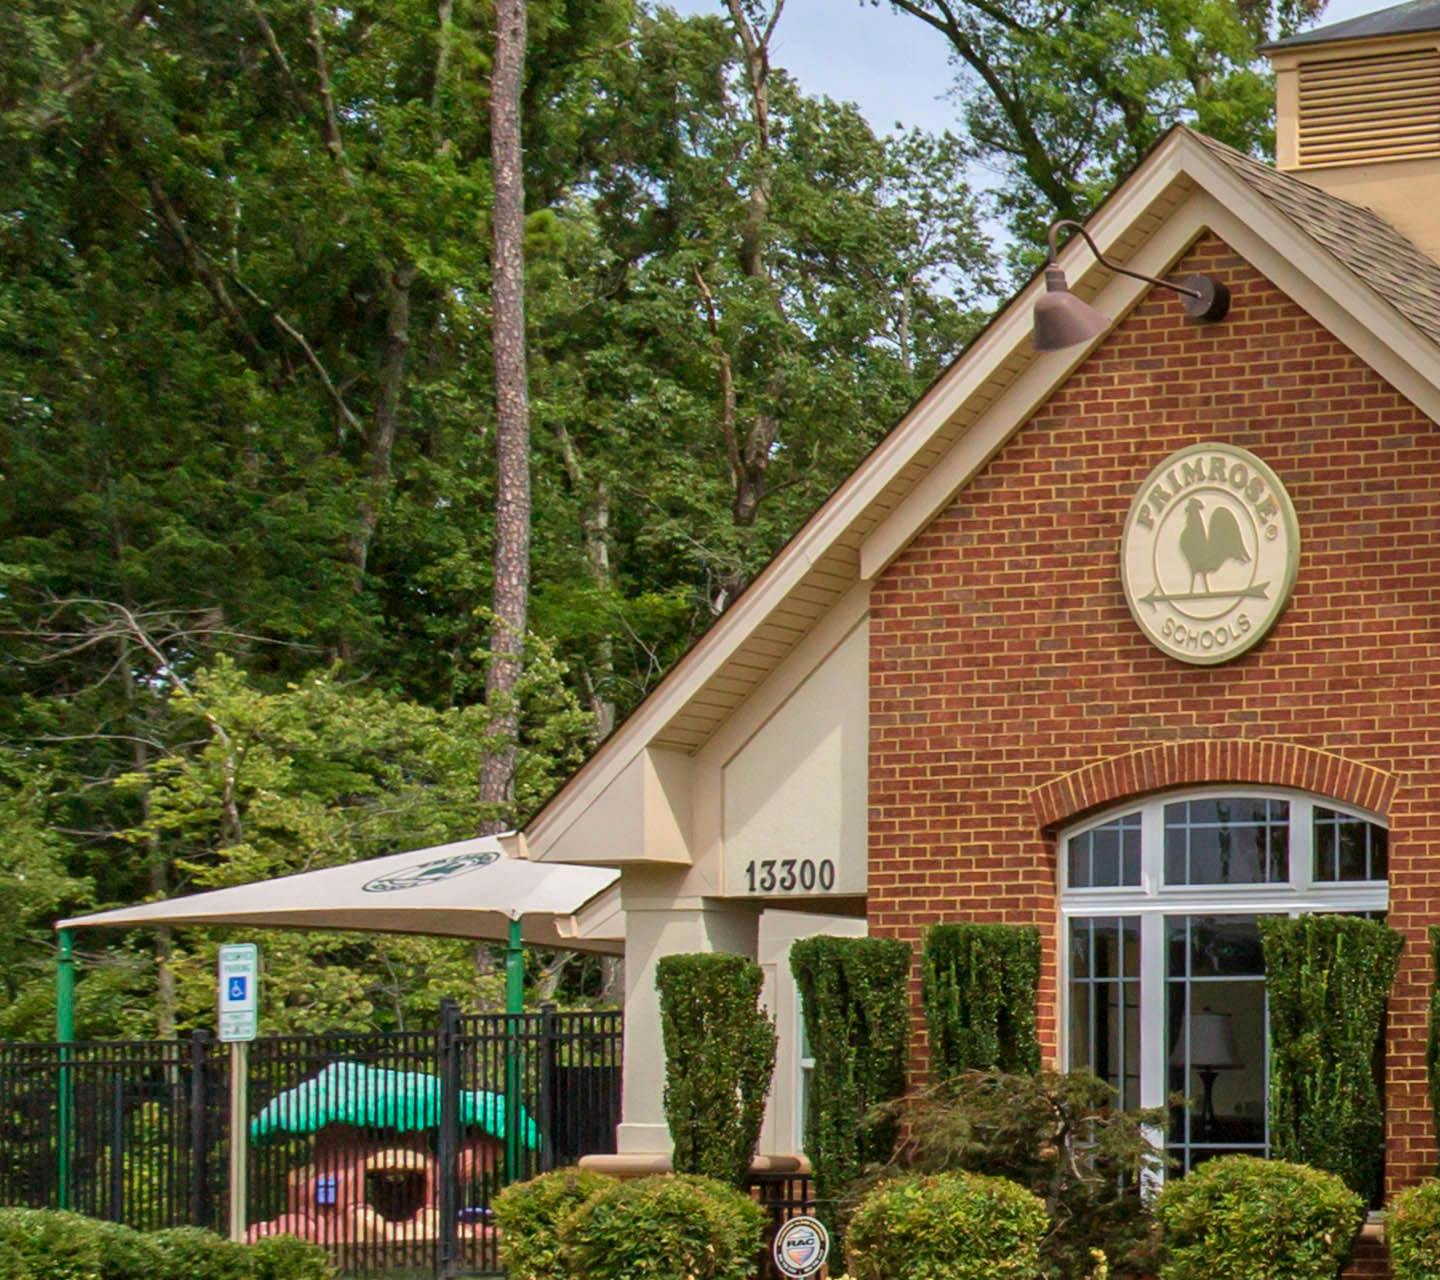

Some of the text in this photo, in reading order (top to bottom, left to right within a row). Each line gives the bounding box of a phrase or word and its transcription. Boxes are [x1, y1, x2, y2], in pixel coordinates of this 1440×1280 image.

[1136, 456, 1278, 531] PRIMROSE
[1161, 613, 1251, 650] SCHOOLS
[745, 858, 835, 892] 13300
